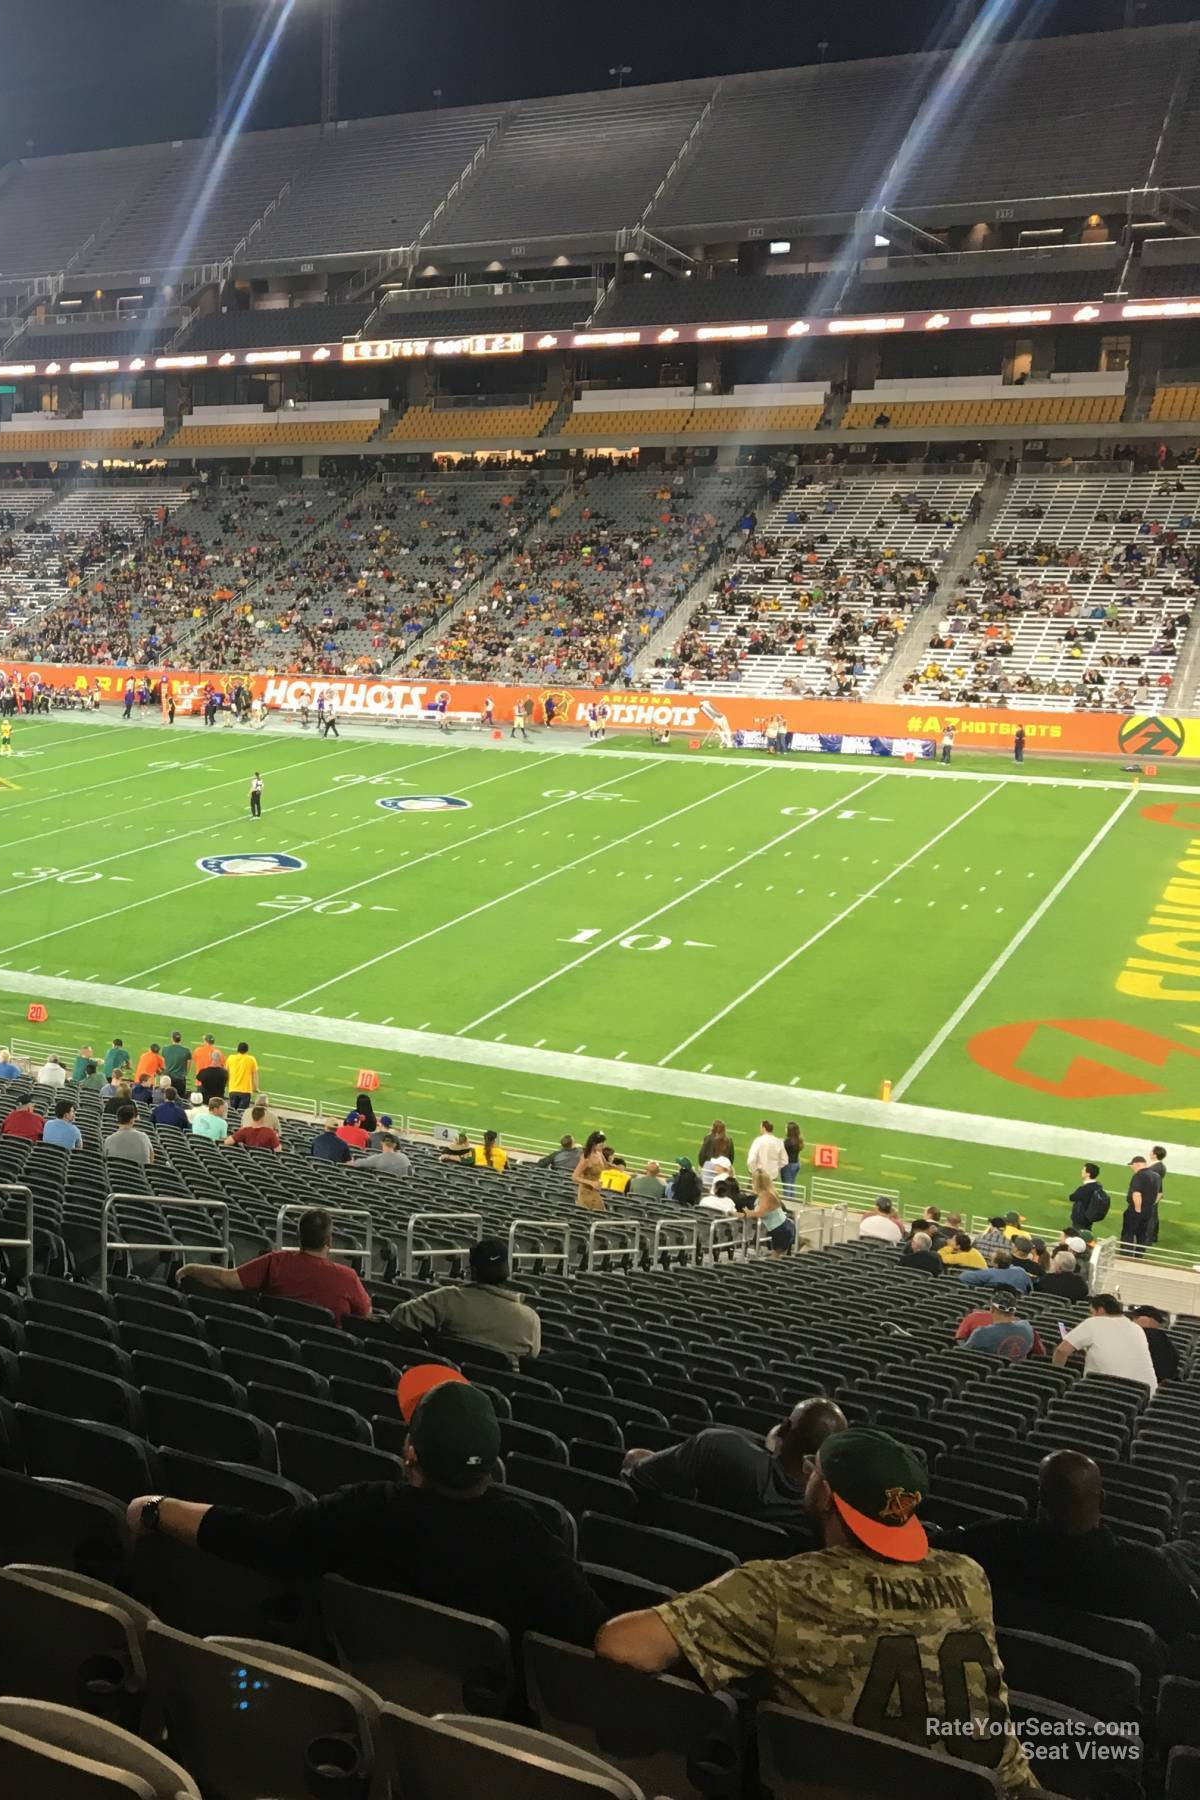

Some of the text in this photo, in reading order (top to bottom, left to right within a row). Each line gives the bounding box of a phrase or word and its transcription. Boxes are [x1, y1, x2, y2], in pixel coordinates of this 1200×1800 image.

[265, 679, 428, 713] HOTSHOTS
[602, 694, 672, 705] ARIZONA
[907, 715, 1062, 738] #AZHOTSOTS
[780, 806, 867, 819] 10
[12, 866, 103, 884] 30
[256, 894, 363, 915] 20
[556, 928, 673, 951] 10
[30, 1005, 42, 1018] 20
[360, 1071, 372, 1088] 10
[441, 1128, 449, 1139] 4
[819, 1147, 833, 1164] G
[863, 1575, 969, 1610] TILLMAN
[853, 1630, 1008, 1770] 40
